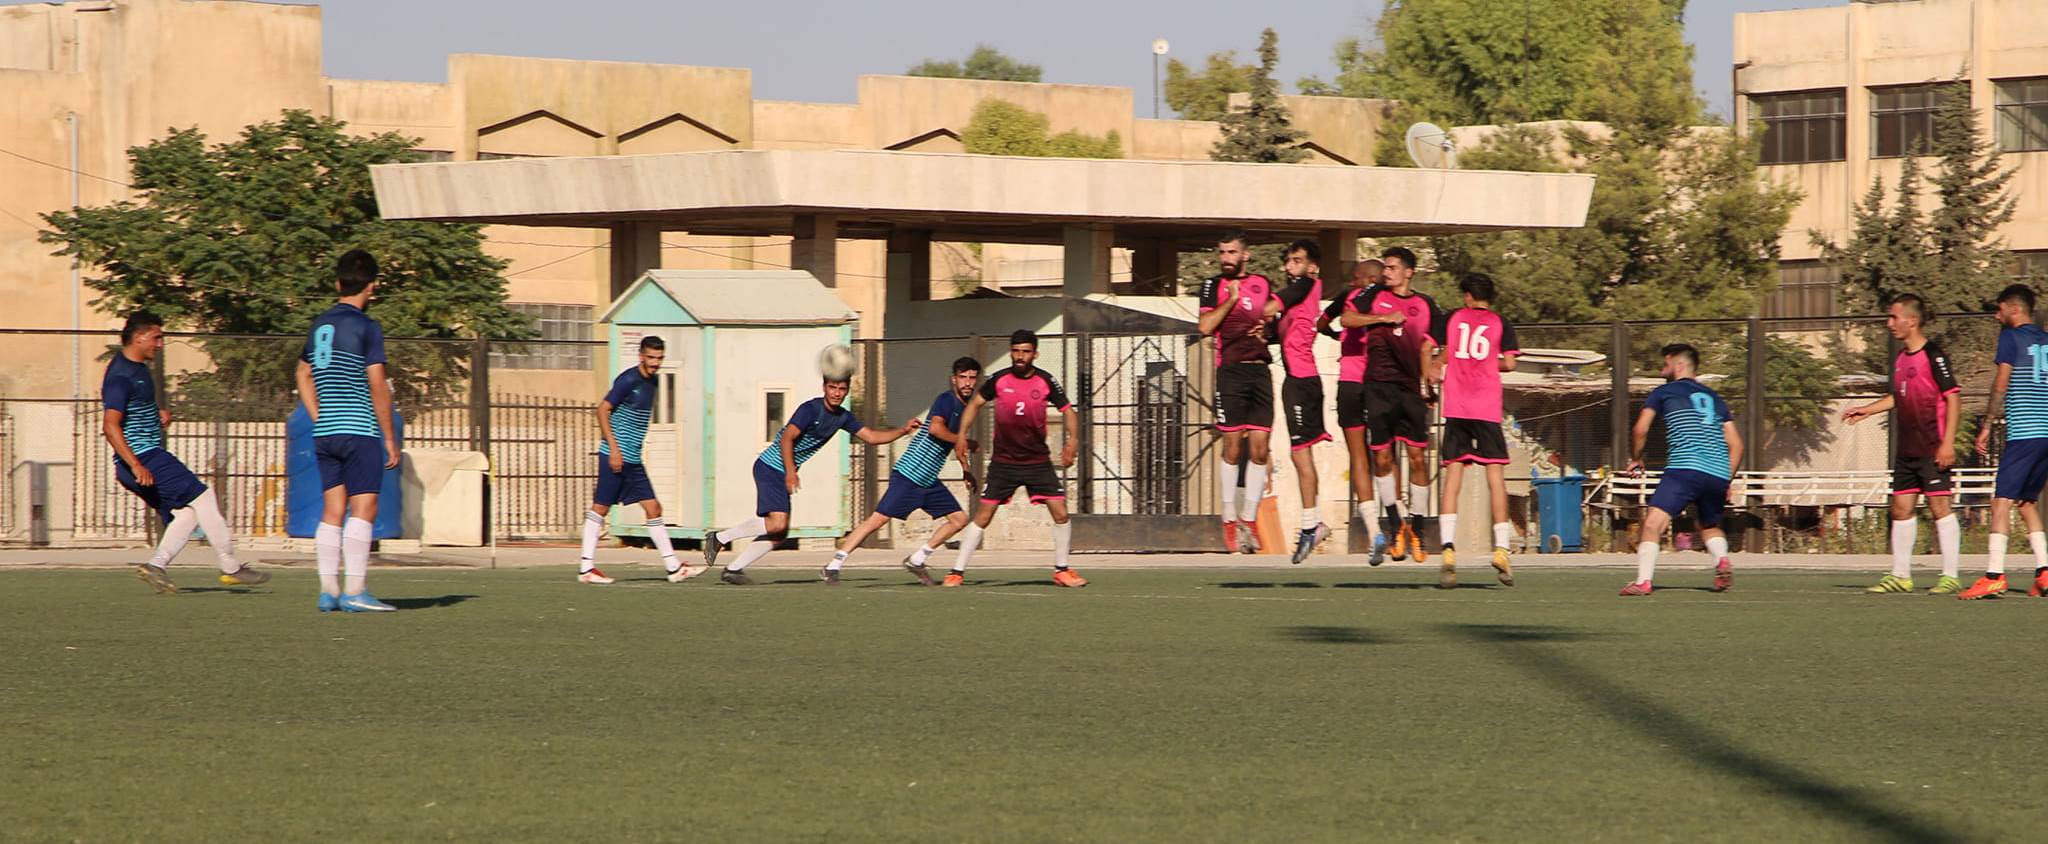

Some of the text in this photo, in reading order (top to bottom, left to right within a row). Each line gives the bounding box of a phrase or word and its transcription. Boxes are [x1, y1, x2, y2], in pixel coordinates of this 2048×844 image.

[1242, 297, 1253, 311] 5
[313, 323, 335, 370] 8
[1455, 321, 1490, 361] 16
[1015, 401, 1026, 416] 2
[1690, 392, 1715, 425] 9
